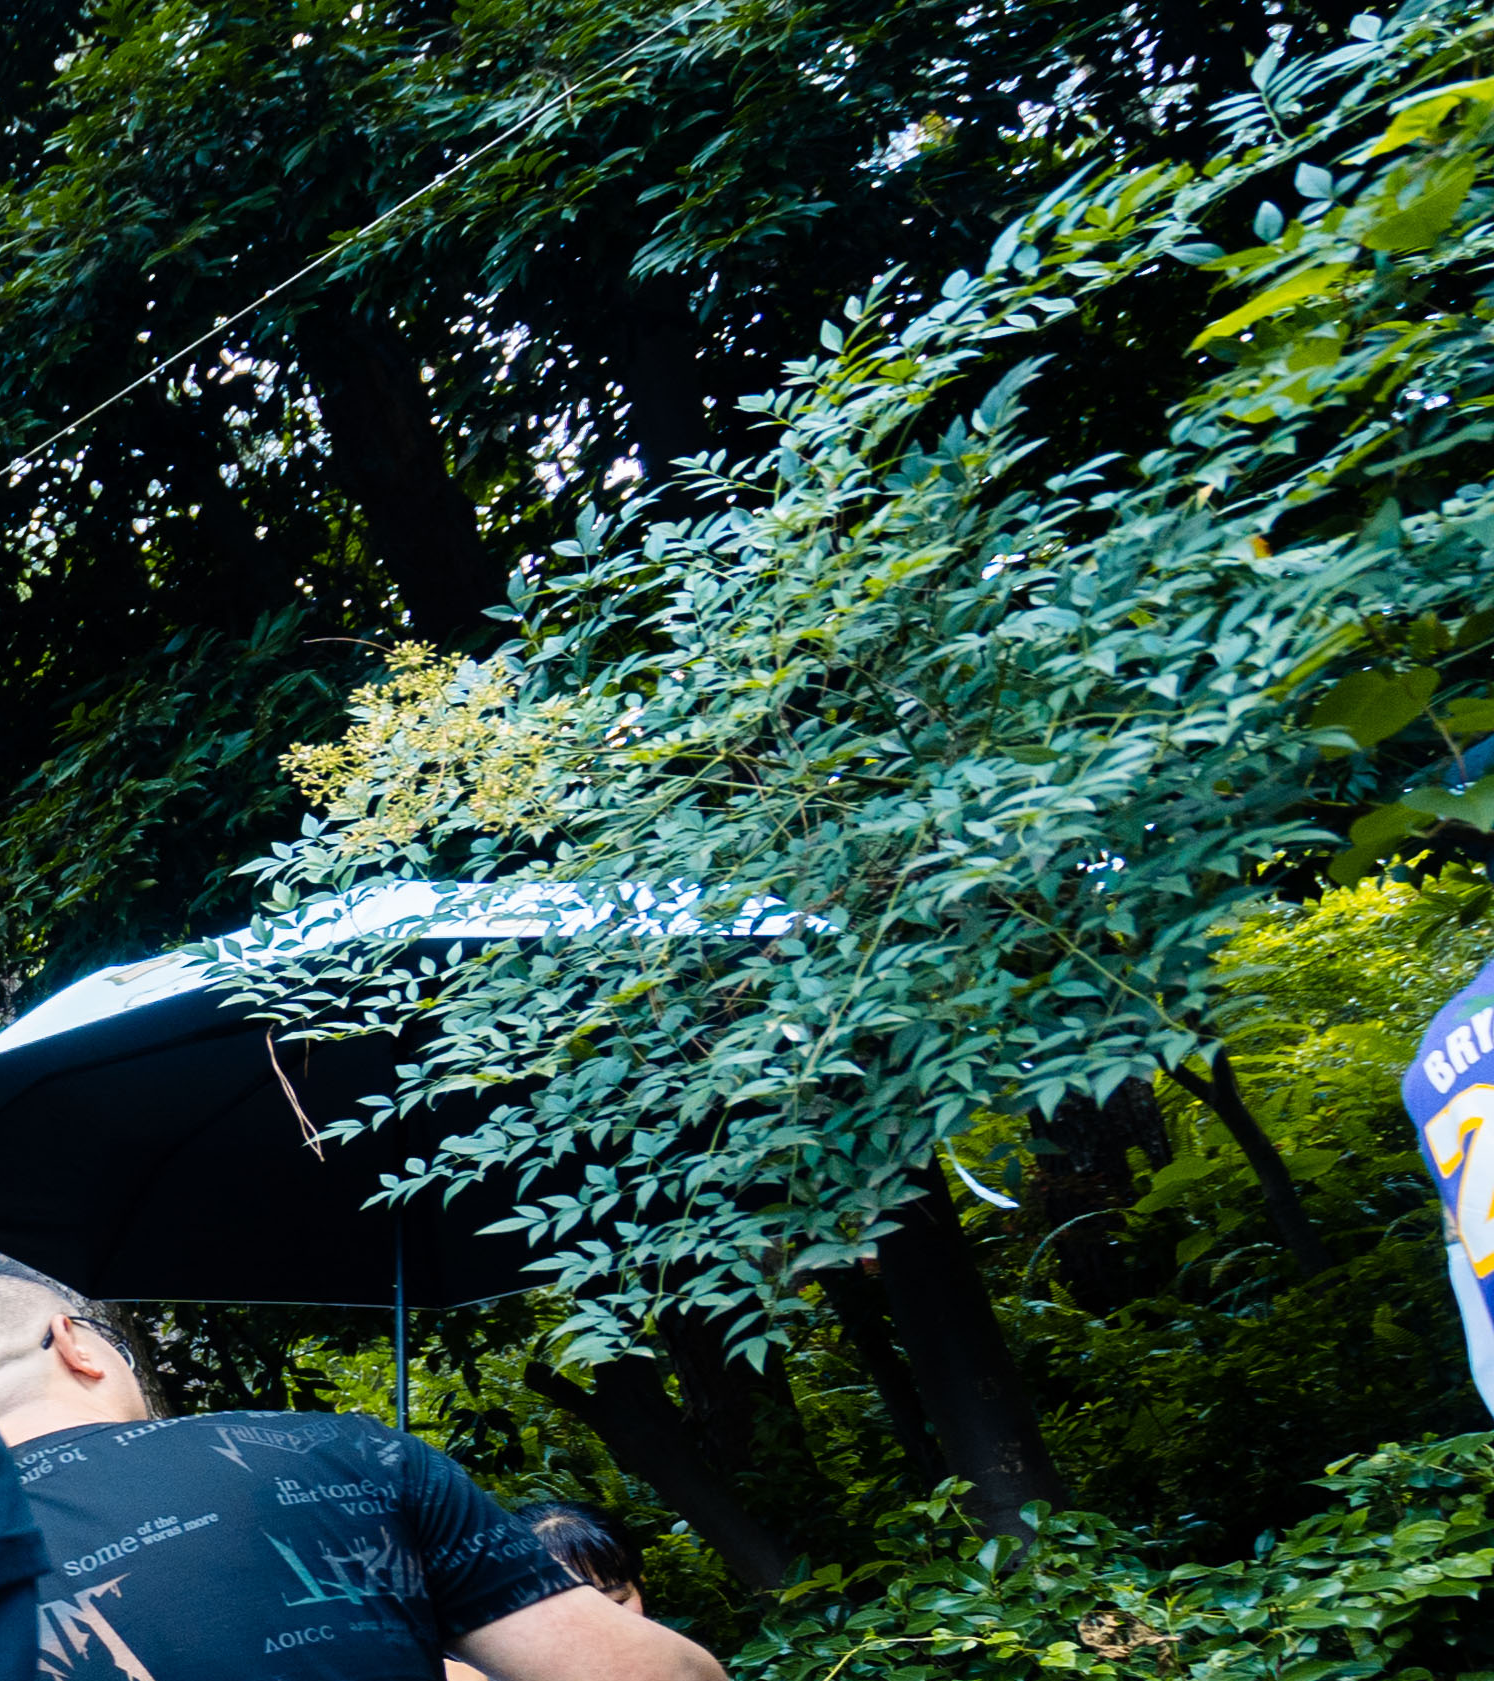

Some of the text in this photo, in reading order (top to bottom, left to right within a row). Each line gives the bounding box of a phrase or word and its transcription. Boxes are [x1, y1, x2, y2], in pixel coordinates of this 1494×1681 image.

[1423, 1007, 1494, 1094] BRY
[273, 1476, 302, 1492] in
[276, 1487, 322, 1506] that
[318, 1479, 375, 1500] tone
[62, 1534, 140, 1577] some
[136, 1521, 154, 1537] of
